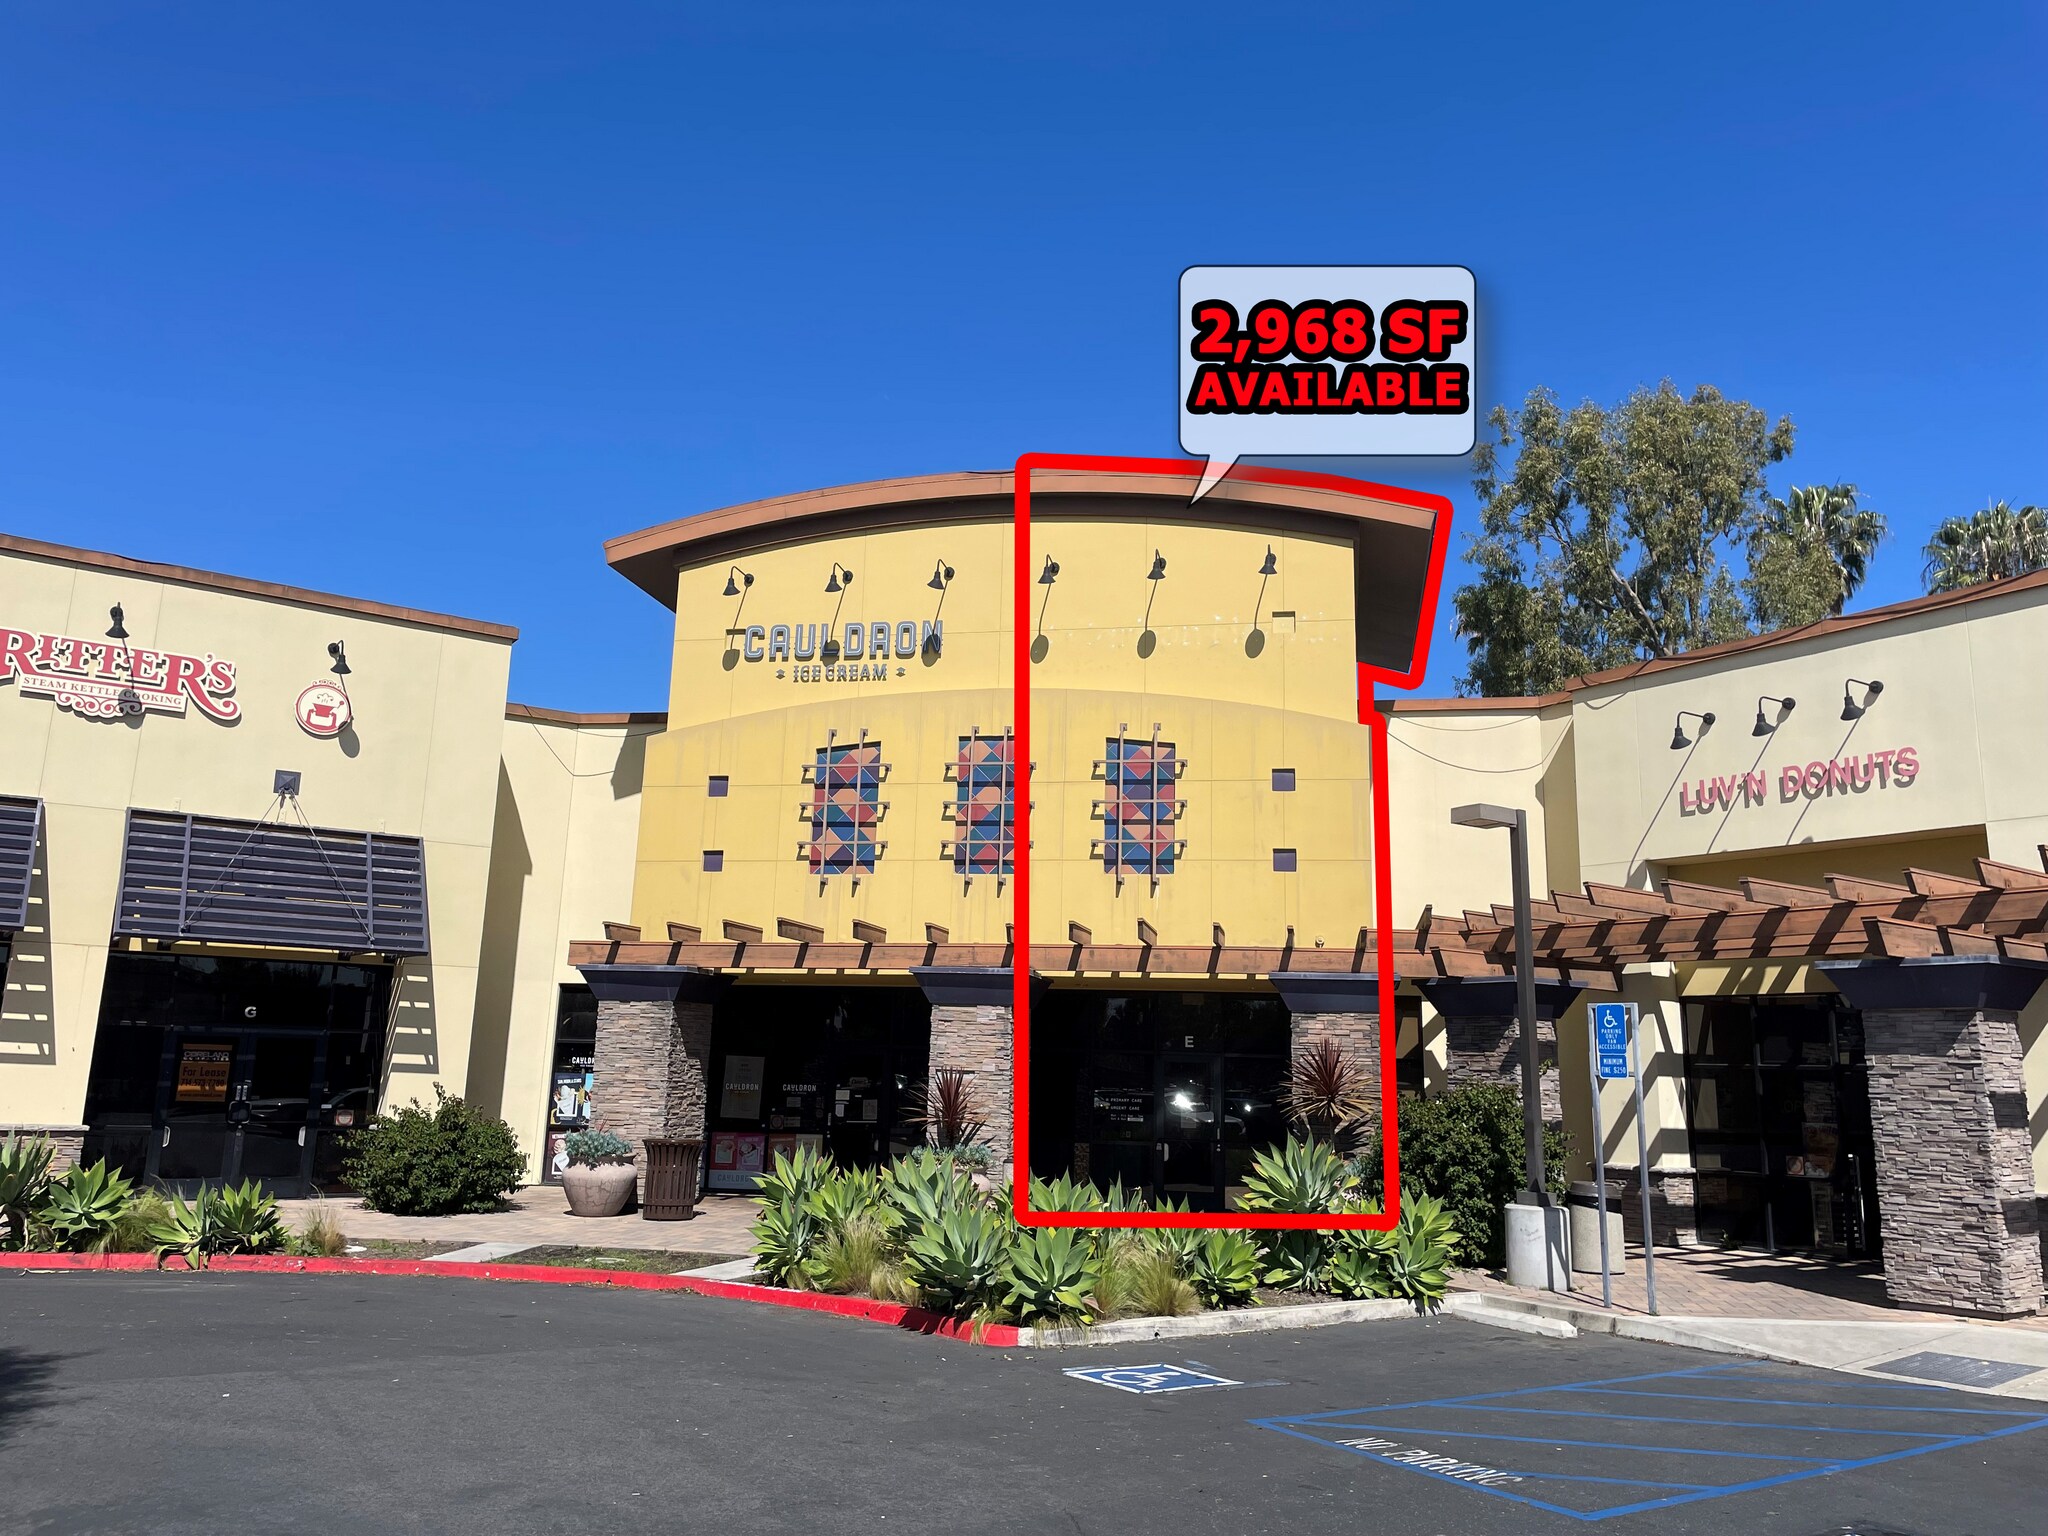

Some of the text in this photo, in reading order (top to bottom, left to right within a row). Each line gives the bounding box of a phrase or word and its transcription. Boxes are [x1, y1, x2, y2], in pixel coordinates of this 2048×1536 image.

[744, 620, 943, 658] CAULDRON
[793, 663, 888, 680] ICE CREAM
[23, 676, 182, 705] STEAM KETTLE COOKING
[1681, 746, 1920, 807] LUV'N DONUTS
[244, 1006, 257, 1018] G
[1184, 1035, 1195, 1048] E
[182, 1066, 227, 1077] For Lease
[1601, 1066, 1626, 1074] FINE $250
[725, 1082, 759, 1091] CAULDRON
[782, 1083, 817, 1092] CAULDRON
[1335, 1437, 1523, 1486] NO PARKING
